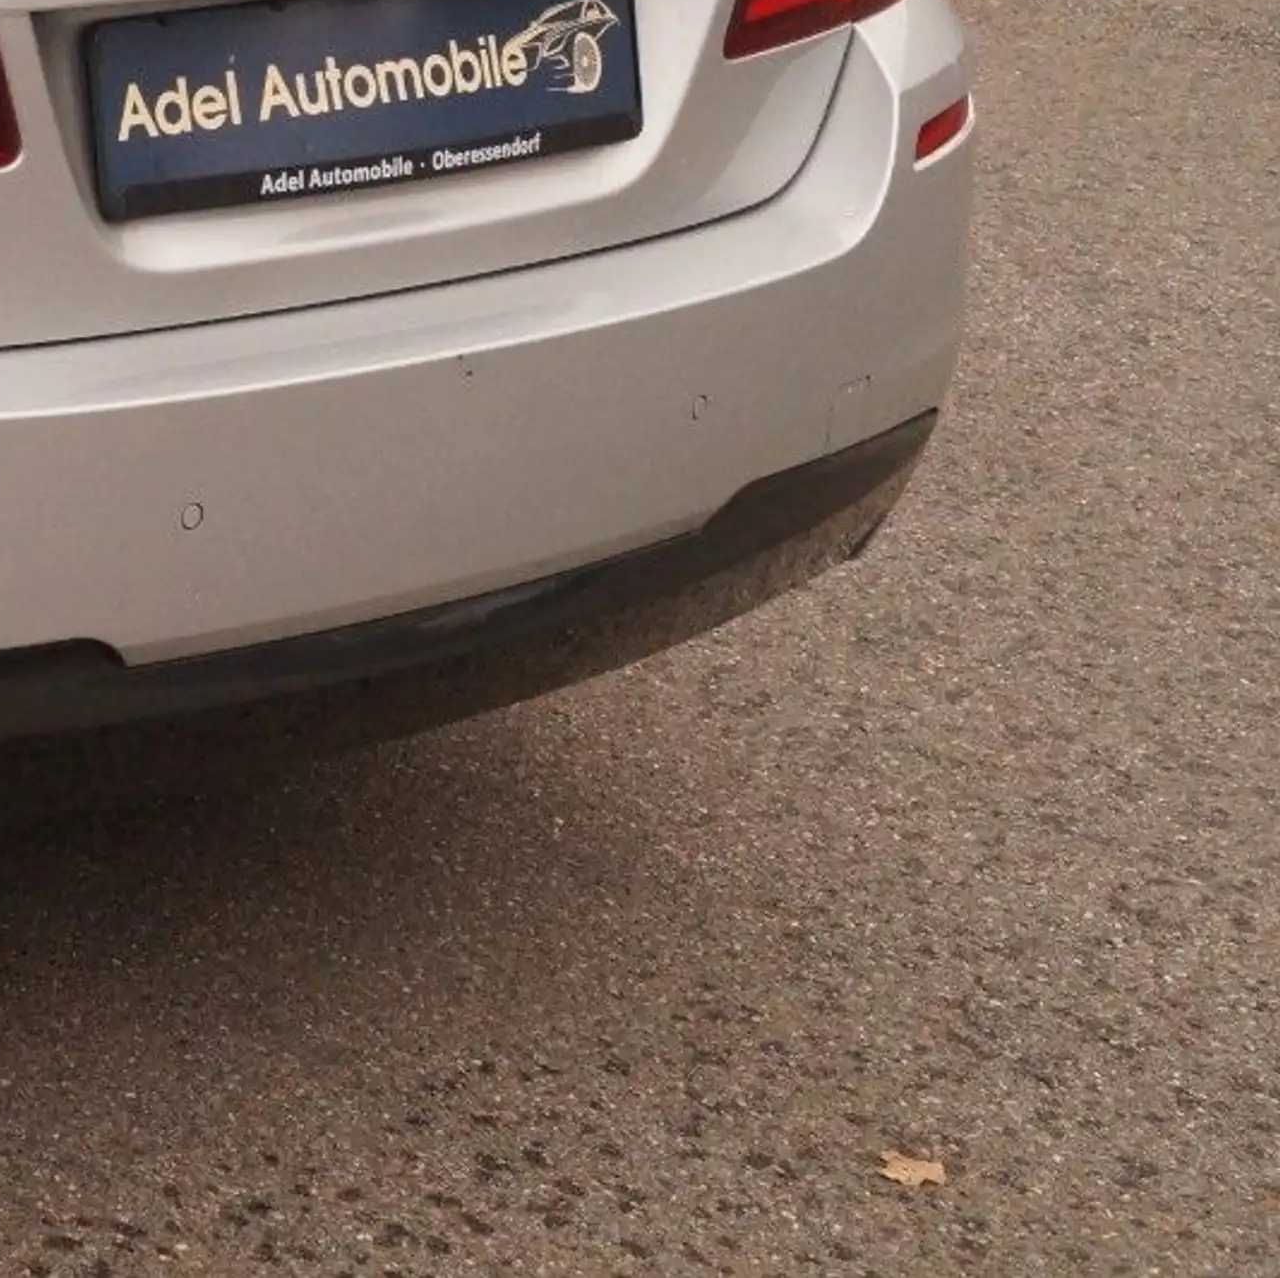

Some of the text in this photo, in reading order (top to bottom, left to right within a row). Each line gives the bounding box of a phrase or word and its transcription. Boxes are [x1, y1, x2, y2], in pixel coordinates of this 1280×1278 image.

[118, 34, 528, 142] Adel Automobile
[260, 132, 541, 196] Adel Automobile Oberessendorf
